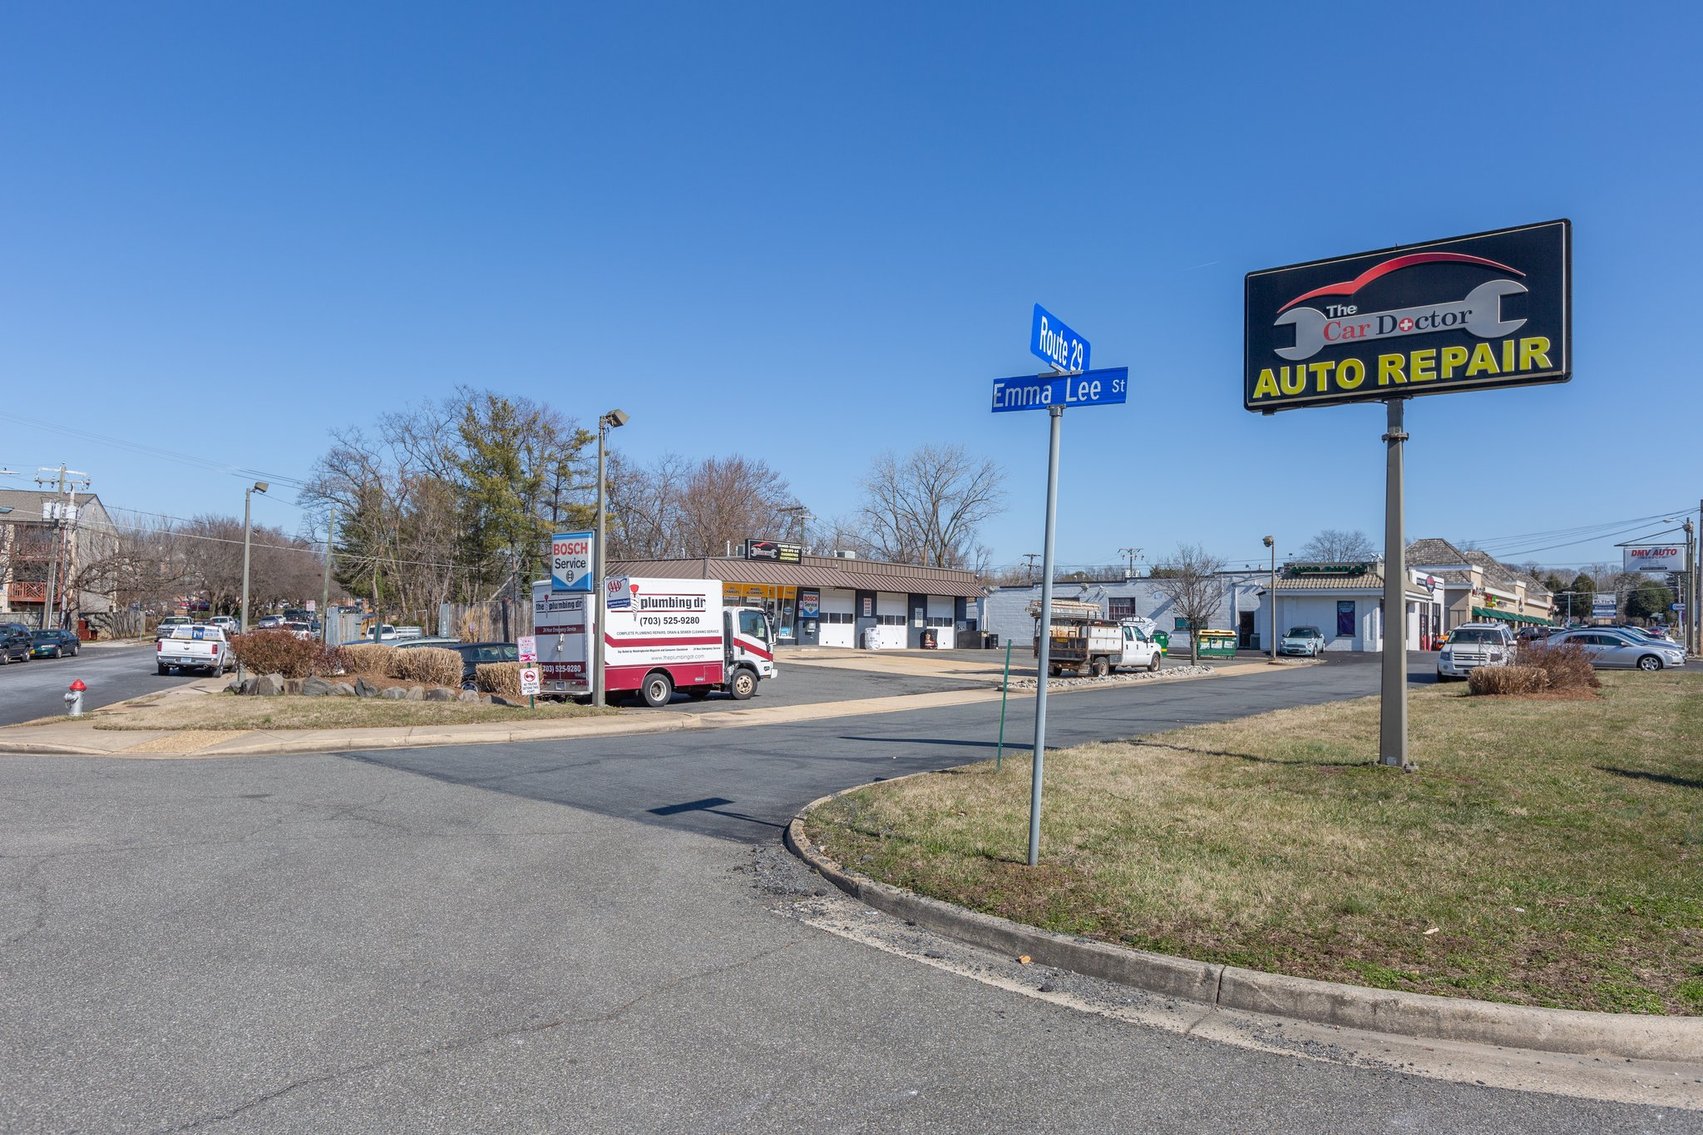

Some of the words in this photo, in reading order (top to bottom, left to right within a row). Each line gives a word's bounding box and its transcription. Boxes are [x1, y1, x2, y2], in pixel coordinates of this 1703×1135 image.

[1326, 303, 1358, 318] The
[1323, 320, 1370, 342] Car
[1375, 308, 1473, 336] Doctor
[1039, 315, 1068, 366] Route
[1070, 338, 1084, 372] 29
[1252, 357, 1366, 399] AUTO
[1377, 336, 1553, 386] REPAIR
[993, 383, 1052, 408] Emma
[1065, 377, 1102, 402] Lee
[1112, 379, 1126, 393] St
[553, 542, 588, 556] BOSCH
[1631, 549, 1651, 557] DMV
[1652, 548, 1678, 557] AUTO
[554, 557, 587, 569] Service
[536, 603, 544, 611] the
[549, 601, 575, 611] plumbing
[640, 596, 692, 610] plumbing
[694, 597, 706, 608] dr
[640, 617, 661, 627] (703)
[663, 616, 700, 625] 525-9280
[555, 664, 582, 673] 525-9280
